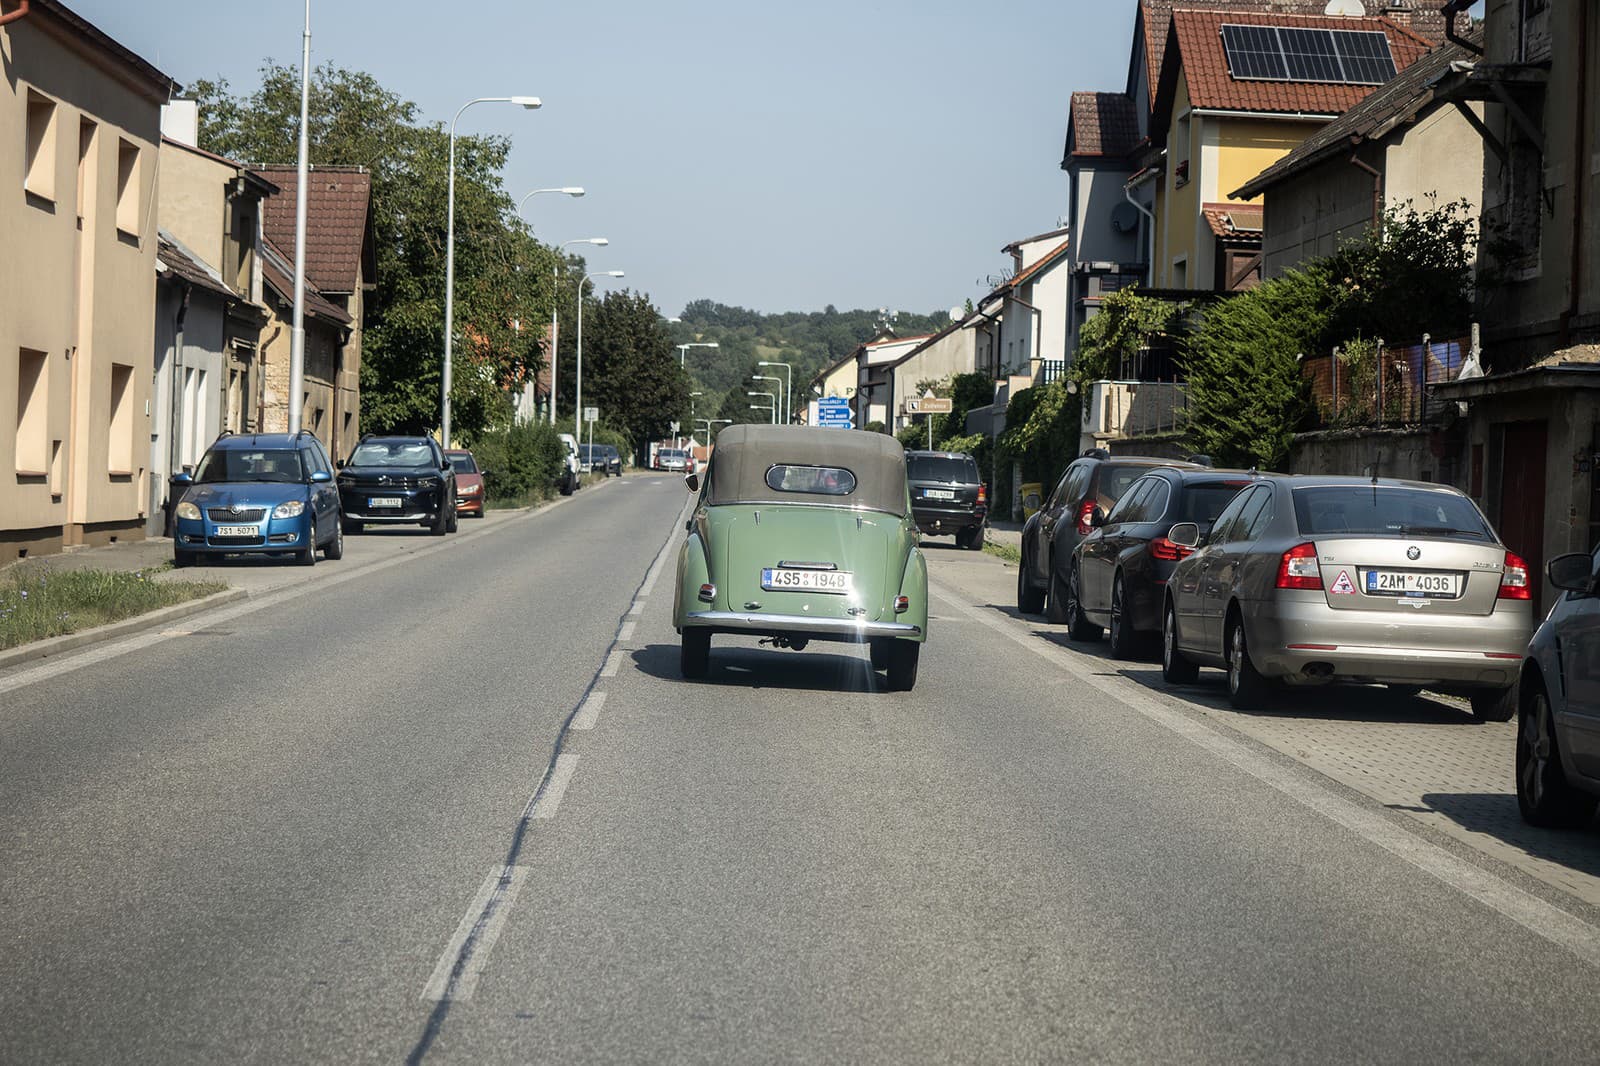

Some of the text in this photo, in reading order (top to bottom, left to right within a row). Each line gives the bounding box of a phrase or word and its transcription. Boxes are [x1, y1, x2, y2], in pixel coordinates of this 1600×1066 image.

[219, 527, 255, 535] 7S1 5071
[775, 572, 801, 585] 4S5
[812, 574, 846, 587] 1948
[1380, 574, 1406, 590] 2AM
[1416, 576, 1449, 591] 4036
